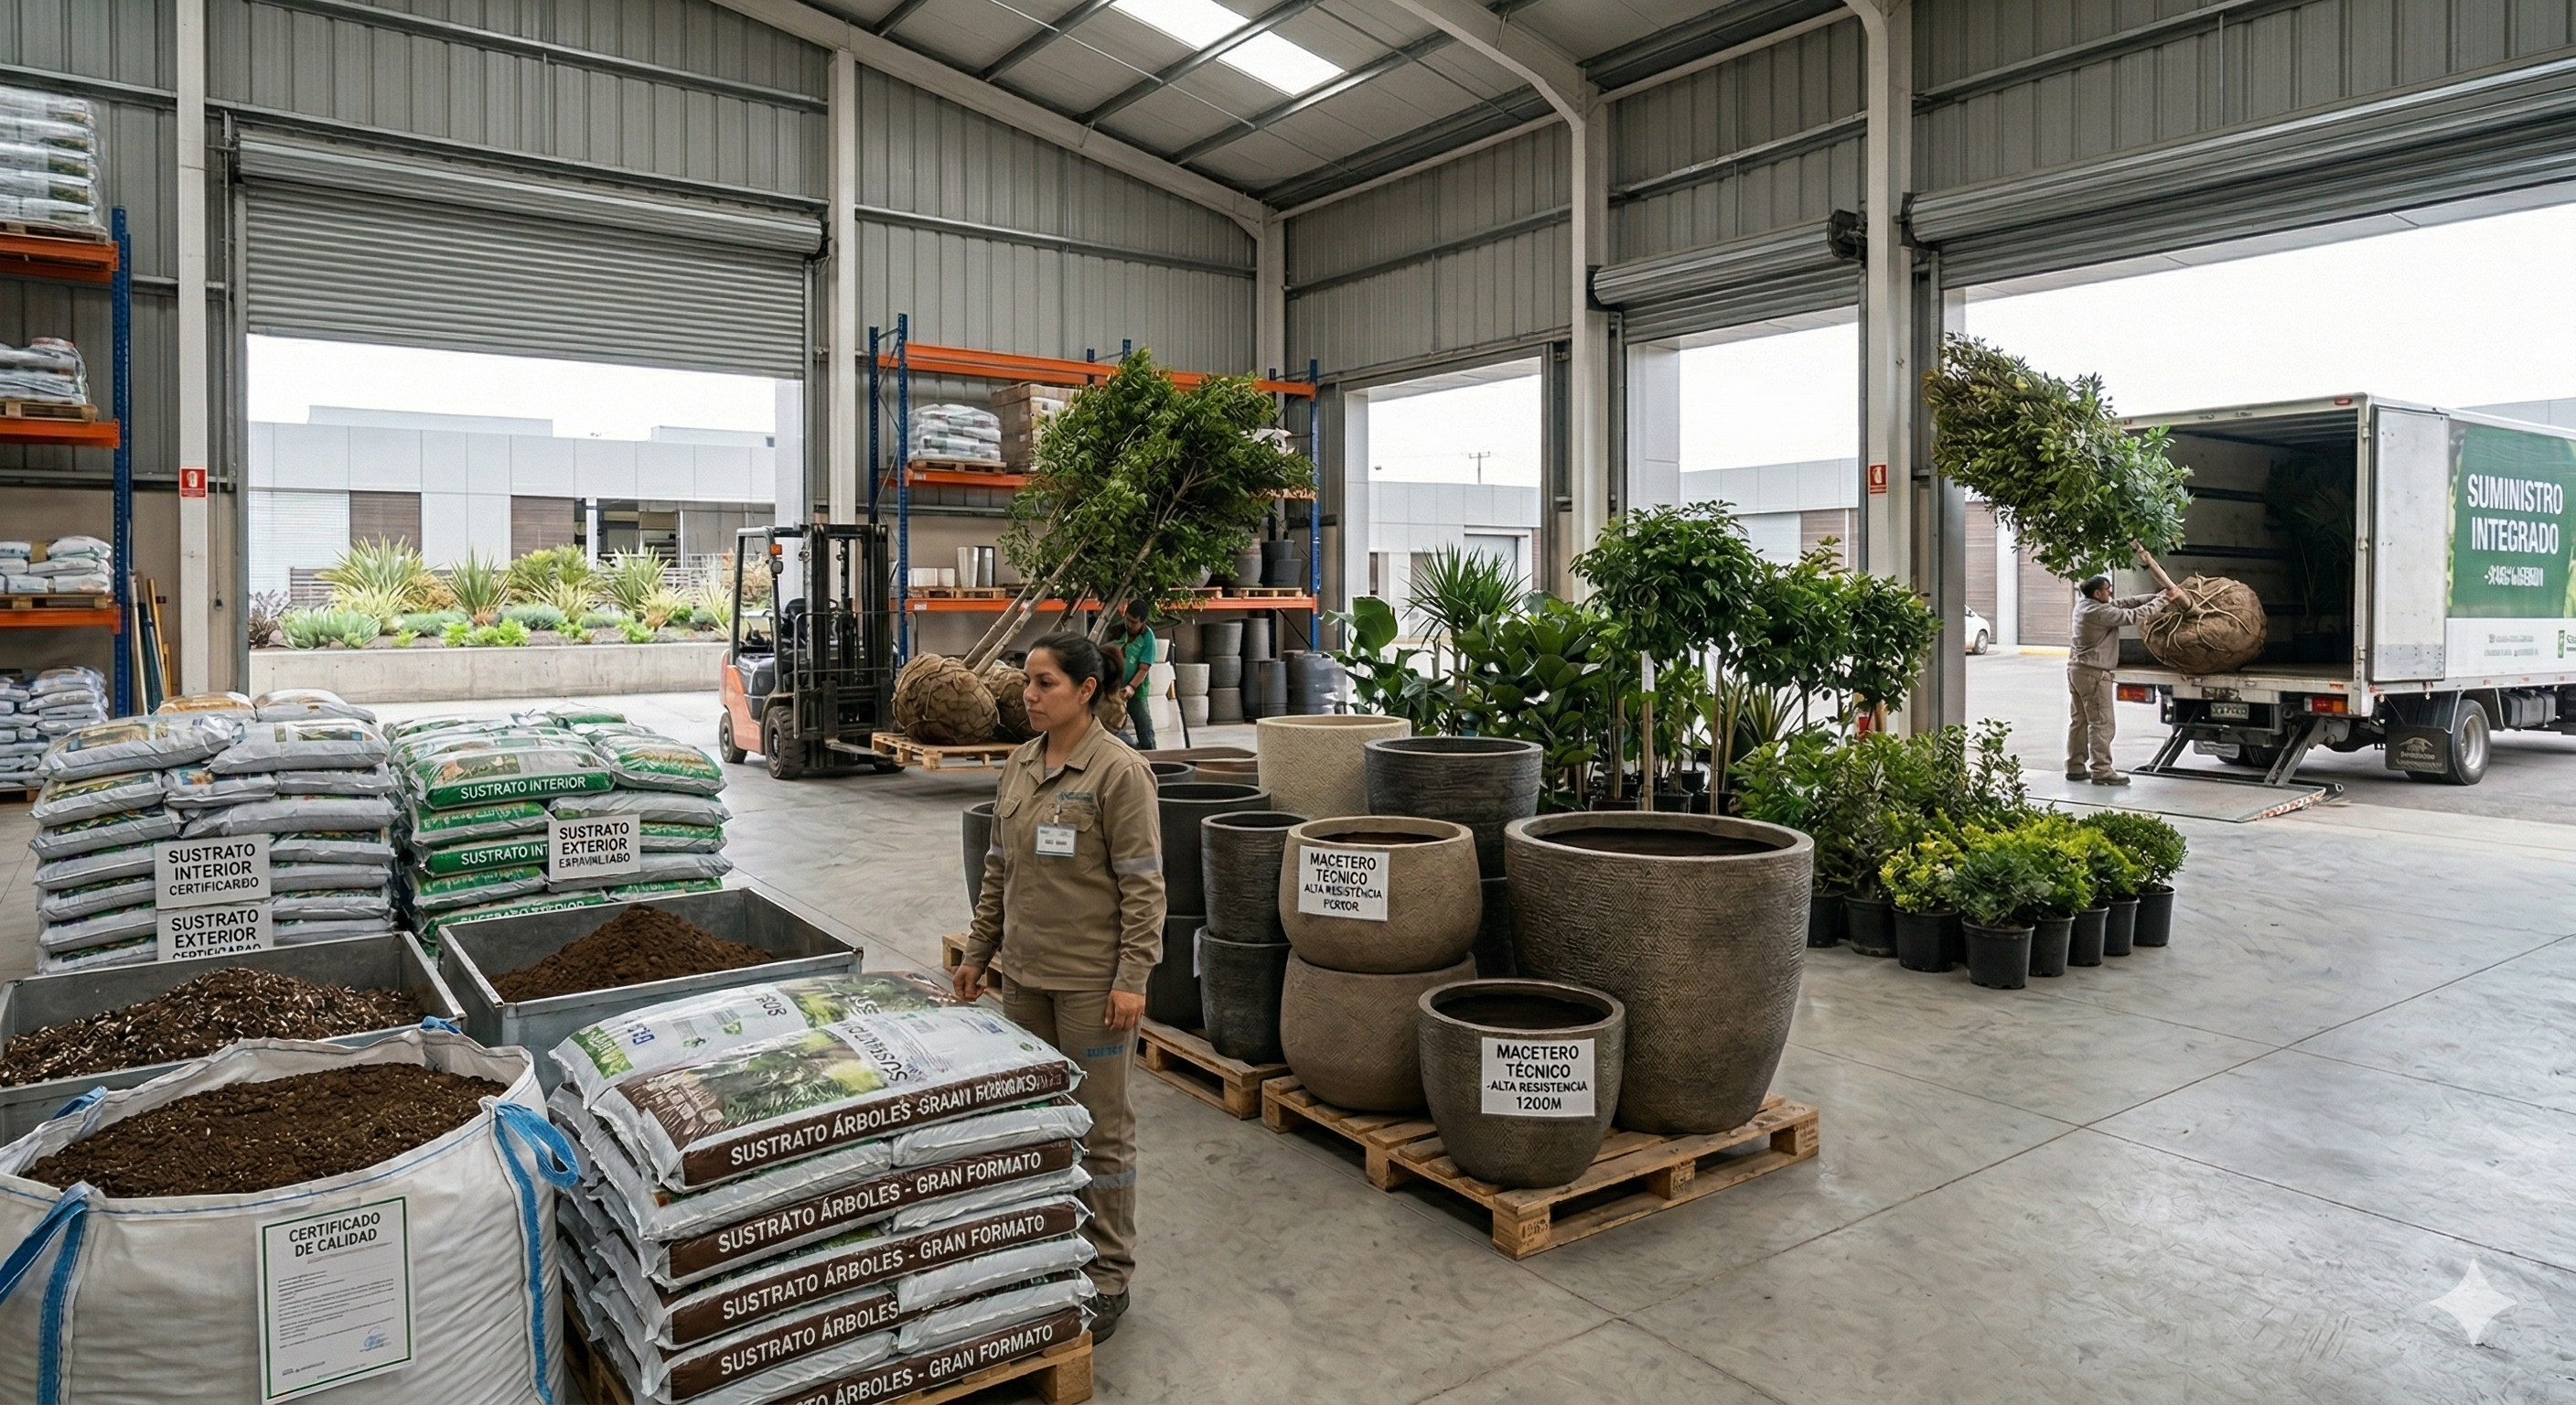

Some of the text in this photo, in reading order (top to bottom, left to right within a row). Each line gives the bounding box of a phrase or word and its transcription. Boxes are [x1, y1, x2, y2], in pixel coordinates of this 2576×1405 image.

[2467, 473, 2563, 515] SUMINISTRO
[2472, 516, 2559, 554] INTEGRADO
[461, 777, 585, 799] SUSTRATO INTERIOR
[559, 822, 629, 840] SUSTRATO
[168, 843, 255, 863] SUSTRATO
[461, 846, 528, 865] SUSTRATO
[562, 837, 628, 855] EXTERIOR
[175, 861, 252, 880] INTERIOR
[1310, 853, 1376, 870] MACETERO
[171, 909, 259, 931] SUSTRATO
[175, 927, 256, 949] EXTERIOR
[1497, 1045, 1579, 1060] MACETERO
[1506, 1061, 1571, 1078] TÉCNICO
[1519, 1081, 1588, 1093] RESISTENCIA
[1516, 1096, 1562, 1110] 1200M
[731, 1124, 827, 1166] SUSTRATO
[718, 1207, 815, 1253] SUSTRATO
[821, 1184, 900, 1221] ÁRBOLES
[917, 1167, 962, 1194] GRAN
[967, 1152, 1042, 1183] FORMATO
[289, 1212, 381, 1243] CERTIFICADO
[295, 1241, 314, 1257] DE
[317, 1228, 377, 1252] CALIDAD
[723, 1273, 819, 1320] SUSTRATO
[824, 1249, 904, 1288] ÁRBOLES
[920, 1232, 966, 1260] GRAN
[971, 1215, 1045, 1247] FORMATO
[721, 1301, 898, 1375] SUSTRATO ÁRBOLES
[834, 1368, 913, 1405] ÁRBOLES
[929, 1349, 974, 1378] GRAN
[980, 1325, 1053, 1362] FORMATO
